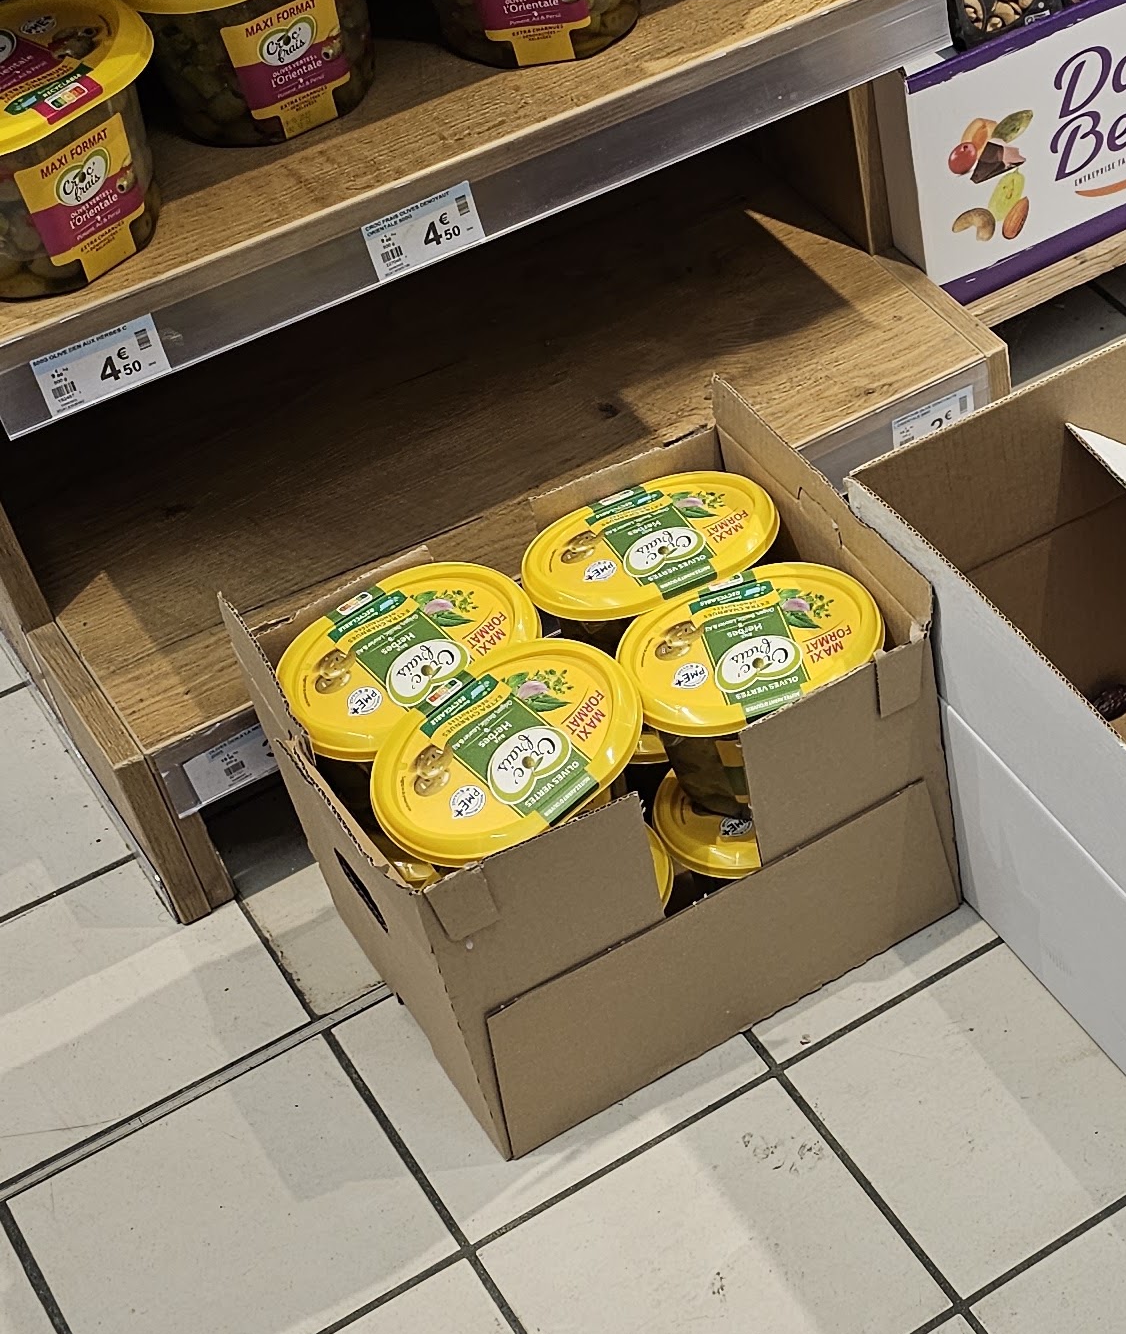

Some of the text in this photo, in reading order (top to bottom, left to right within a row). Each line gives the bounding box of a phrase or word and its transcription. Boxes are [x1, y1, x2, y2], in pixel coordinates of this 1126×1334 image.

[244, 17, 274, 38] MAXI
[277, 38, 306, 64] frais
[271, 58, 323, 88] l'Orientale
[40, 127, 109, 180] MAXI FORMAT
[1074, 162, 1116, 187] ENTREPRISE
[70, 193, 118, 230] l'Orientale
[400, 205, 419, 217] OLIVES
[49, 350, 68, 360] OLIVE
[69, 344, 81, 353] DEN
[82, 338, 95, 347] AUX
[96, 328, 121, 341] HERBES
[380, 632, 416, 655] Herbes
[805, 625, 852, 655] FORMAT
[810, 641, 844, 664] MAXI
[675, 667, 706, 687] PME+
[770, 676, 799, 692] OLIVES
[350, 688, 378, 716] PME+
[735, 683, 768, 700] VERTES
[569, 690, 605, 735] FORMAT
[576, 709, 607, 742] MAXI
[478, 720, 513, 749] Herbes
[497, 734, 531, 773] frais
[552, 760, 580, 785] OLIVES
[455, 788, 480, 818] PME+
[524, 782, 552, 808] VERTES
